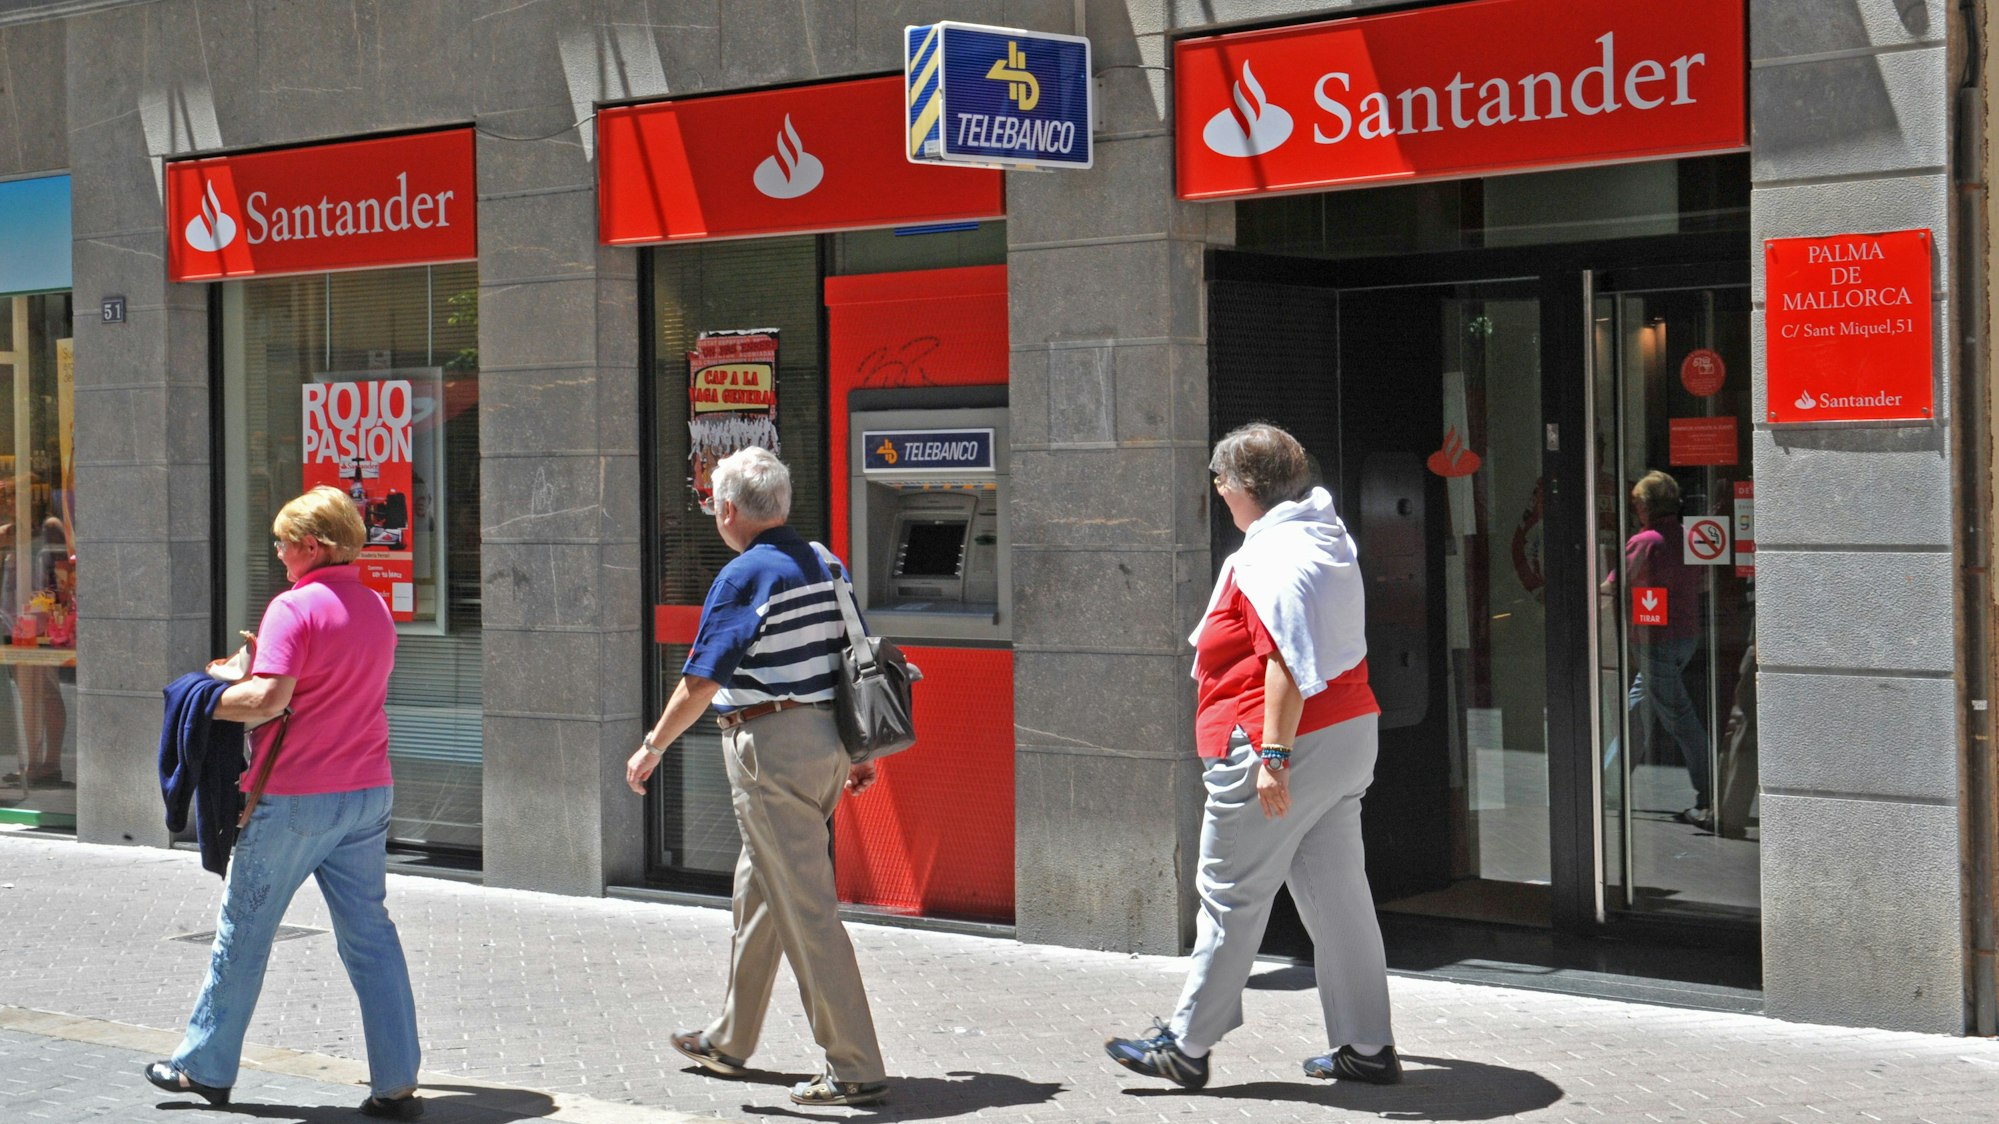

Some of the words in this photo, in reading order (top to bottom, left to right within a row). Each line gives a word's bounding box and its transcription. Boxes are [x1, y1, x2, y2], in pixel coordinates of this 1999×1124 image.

[1312, 32, 1706, 144] Santander
[957, 112, 1075, 154] TELEBANCO
[246, 171, 454, 245] Santander
[1808, 242, 1885, 264] PALMA
[1831, 266, 1862, 286] DE
[1783, 287, 1913, 311] MALLORCA
[104, 303, 121, 320] 51
[1781, 324, 1799, 338] C/
[1804, 323, 1835, 338] Sant
[704, 370, 728, 385] CAP
[730, 371, 739, 386] A
[743, 371, 759, 386] LA
[302, 380, 412, 430] ROJO
[1820, 390, 1903, 409] Santander
[302, 418, 412, 464] PASIÓN
[904, 441, 978, 461] TELEBANCO
[1639, 614, 1661, 623] TIRAR
